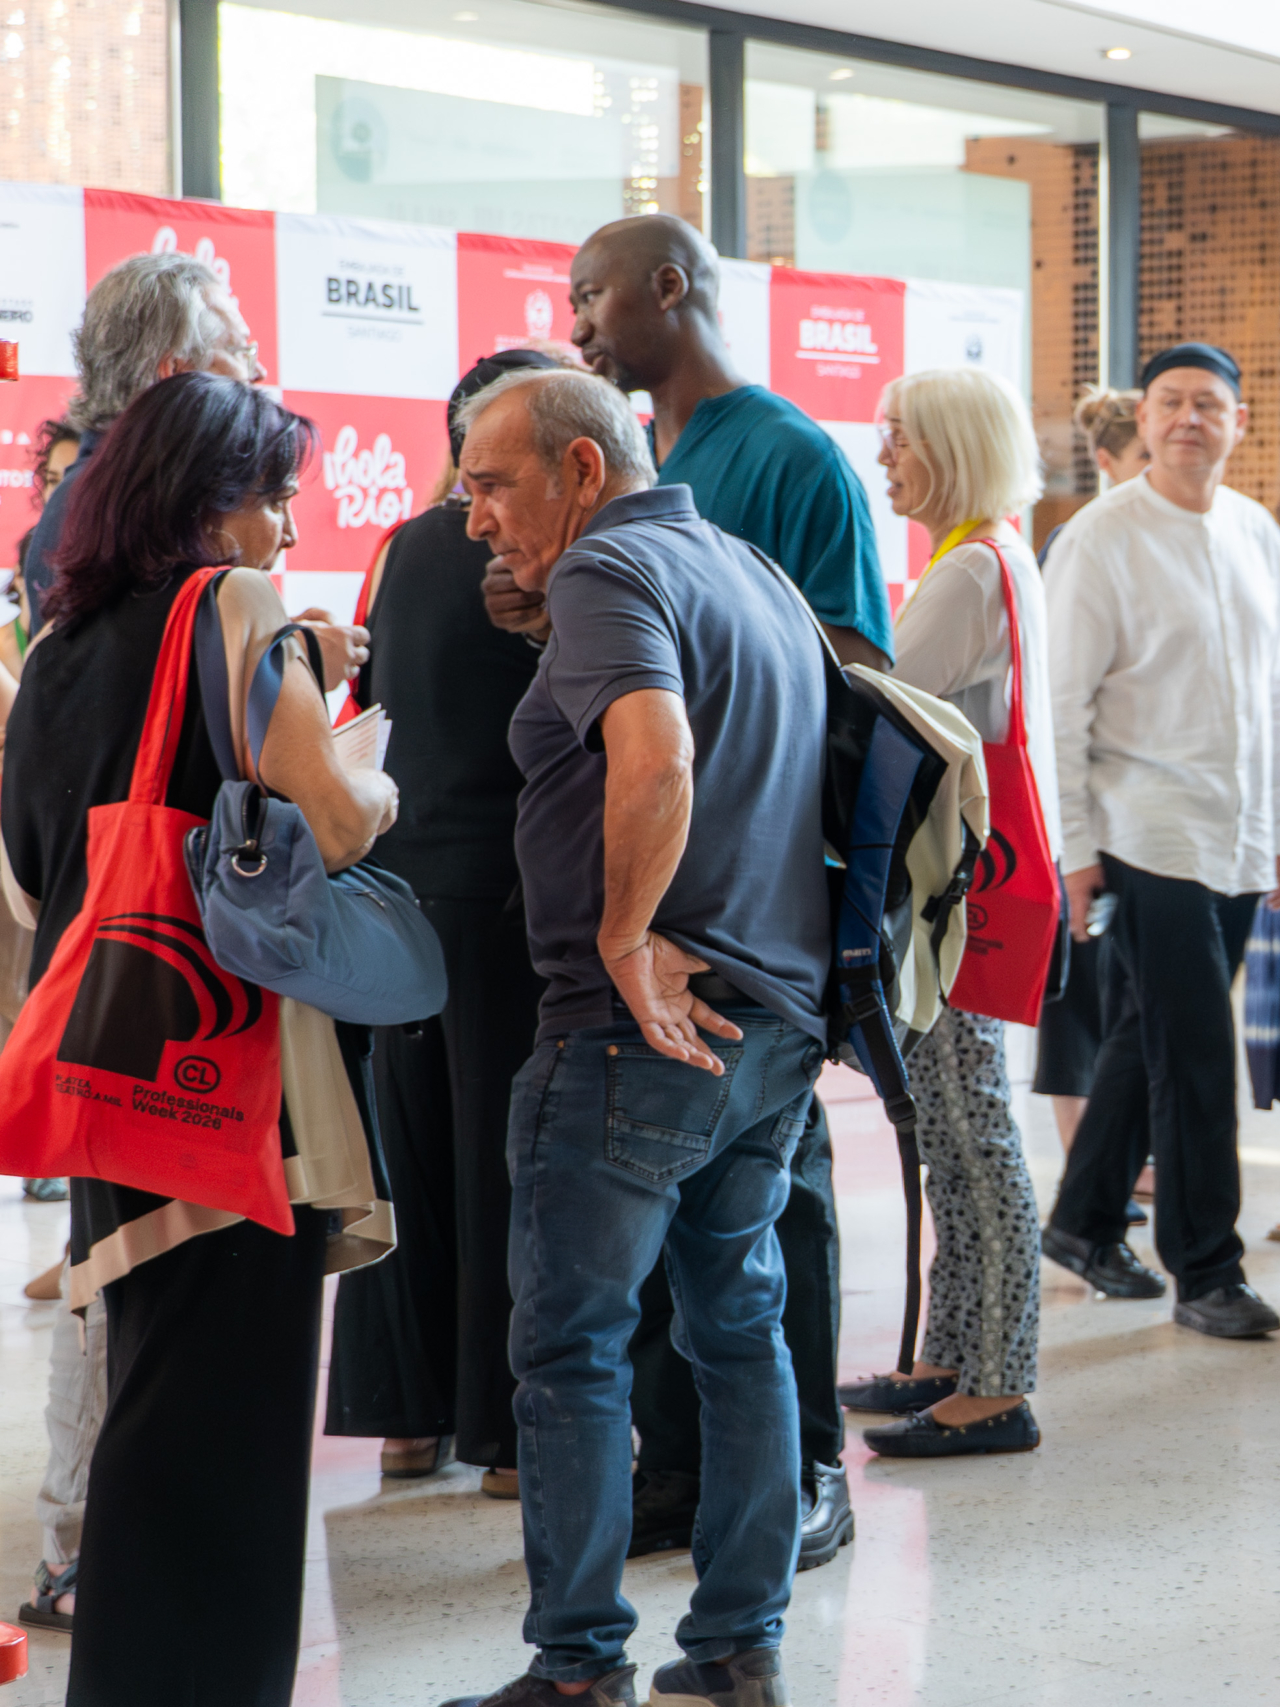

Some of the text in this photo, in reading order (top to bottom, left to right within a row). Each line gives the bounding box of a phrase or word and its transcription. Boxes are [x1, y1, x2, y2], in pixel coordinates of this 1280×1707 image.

[326, 276, 420, 312] BRASIL
[799, 319, 878, 354] BRASIL
[132, 1084, 245, 1122] Professionals
[132, 1097, 179, 1121] Week
